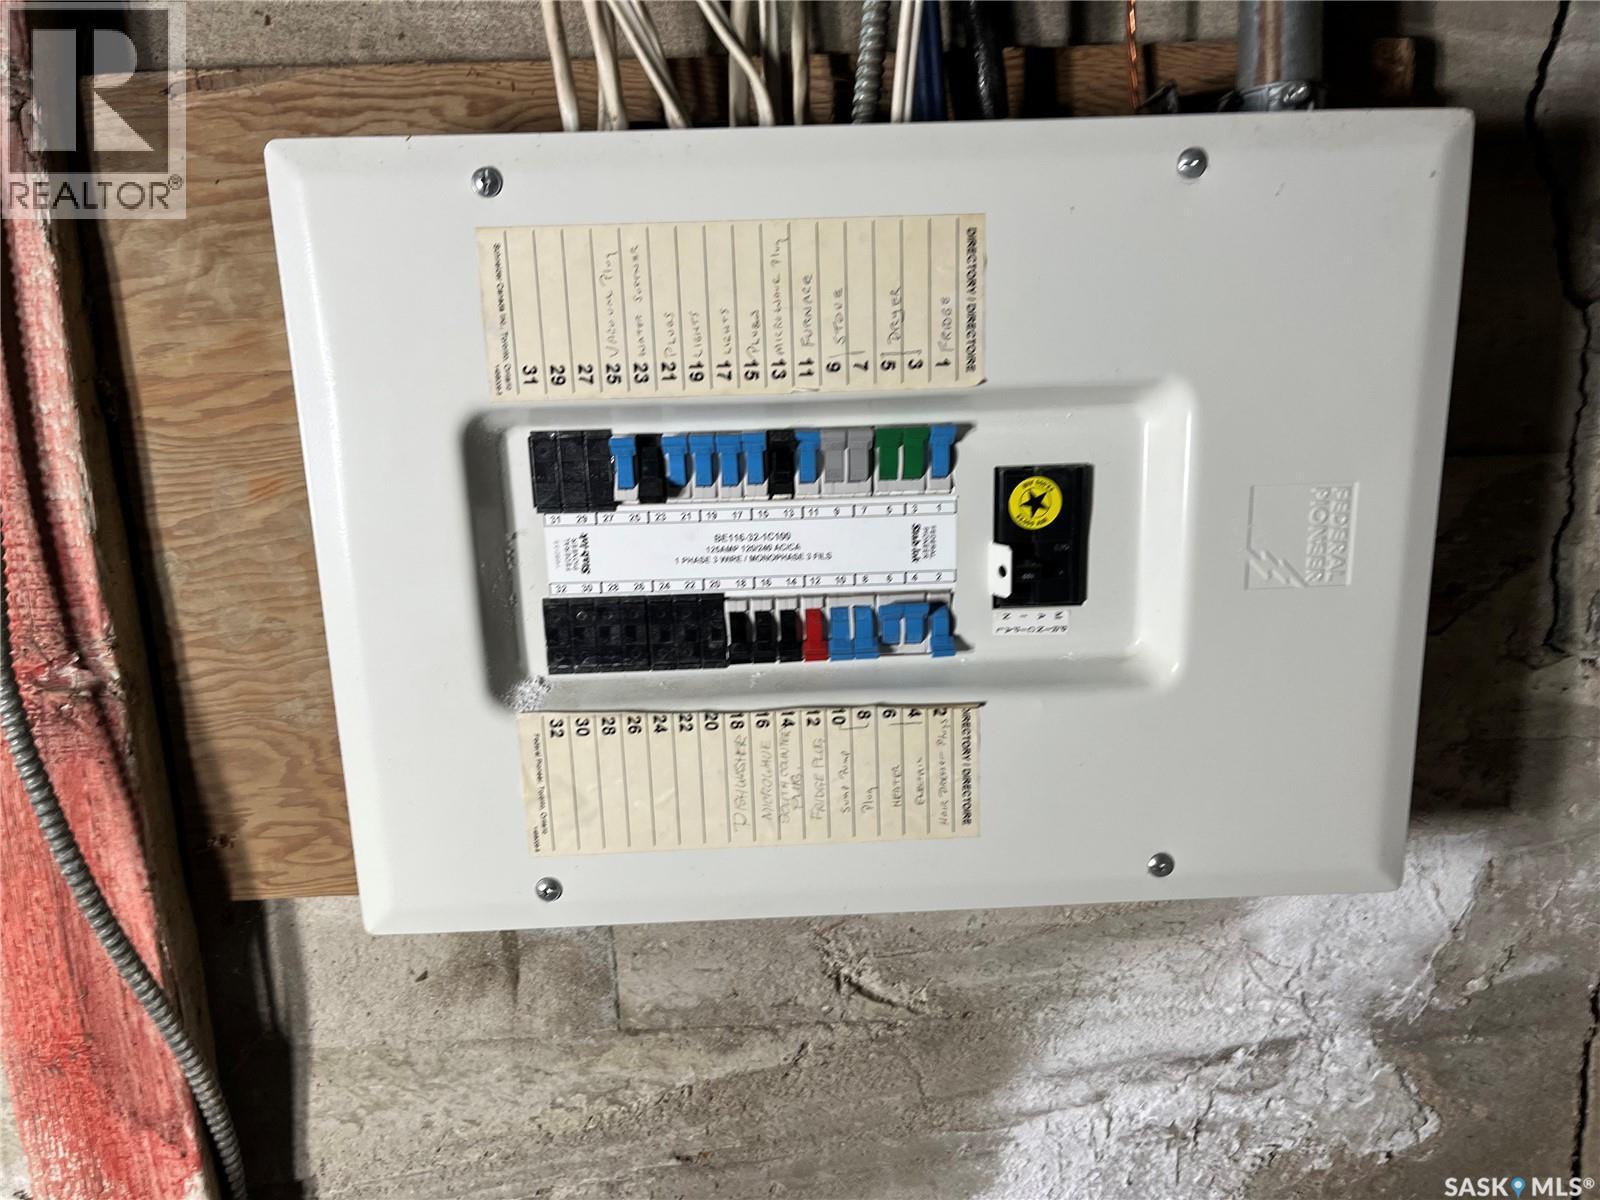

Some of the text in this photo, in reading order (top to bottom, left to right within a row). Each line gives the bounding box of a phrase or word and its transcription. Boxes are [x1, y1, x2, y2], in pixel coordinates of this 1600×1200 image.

[966, 227, 977, 294] DIRECTORY
[801, 273, 815, 347] FURNACE
[833, 287, 847, 345] STOVE
[887, 286, 905, 345] DRYER
[938, 296, 954, 352] FRIDGE
[965, 303, 977, 373] DIRECTOIRE
[633, 362, 649, 385] 23
[661, 362, 677, 382] 21
[688, 360, 705, 382] 19
[716, 360, 732, 381] 17
[743, 359, 759, 381] 15
[771, 358, 787, 380] 13
[798, 358, 814, 378] 11
[825, 361, 841, 373] 9
[853, 360, 869, 371] 7
[880, 360, 896, 371] 5
[908, 359, 923, 370] 3
[935, 358, 951, 369] 1
[522, 364, 539, 385] 31
[549, 365, 566, 386] 29
[577, 364, 594, 385] 27
[605, 363, 622, 385] 25
[550, 504, 942, 524] 31 29 27 25 23 21 19 17 15 13 11 9 7 5 3 1
[1304, 487, 1331, 584] PIONEER
[1327, 487, 1352, 581] FEDERAL
[681, 556, 711, 564] PHASE
[720, 555, 744, 563] WIRE
[749, 553, 804, 562] MONOPHASE
[555, 572, 943, 593] 32 30 28 26 24 22 20 18 16 14 12 10 8 6 4 2
[679, 713, 693, 732] 22
[704, 713, 719, 731] 20
[730, 712, 745, 730] 18
[755, 712, 770, 728] 16
[781, 711, 796, 728] 14
[806, 710, 821, 727] 12
[832, 709, 846, 726] 10
[856, 710, 871, 721] 8
[882, 709, 896, 719] 6
[908, 708, 922, 718] 4
[932, 708, 947, 717] 2
[550, 718, 565, 738] 32
[575, 717, 590, 737] 30
[601, 716, 616, 736] 28
[627, 716, 642, 735] 26
[653, 715, 668, 734] 24
[810, 774, 825, 820] FRIDGE
[961, 768, 972, 826] DIRECTOIRE
